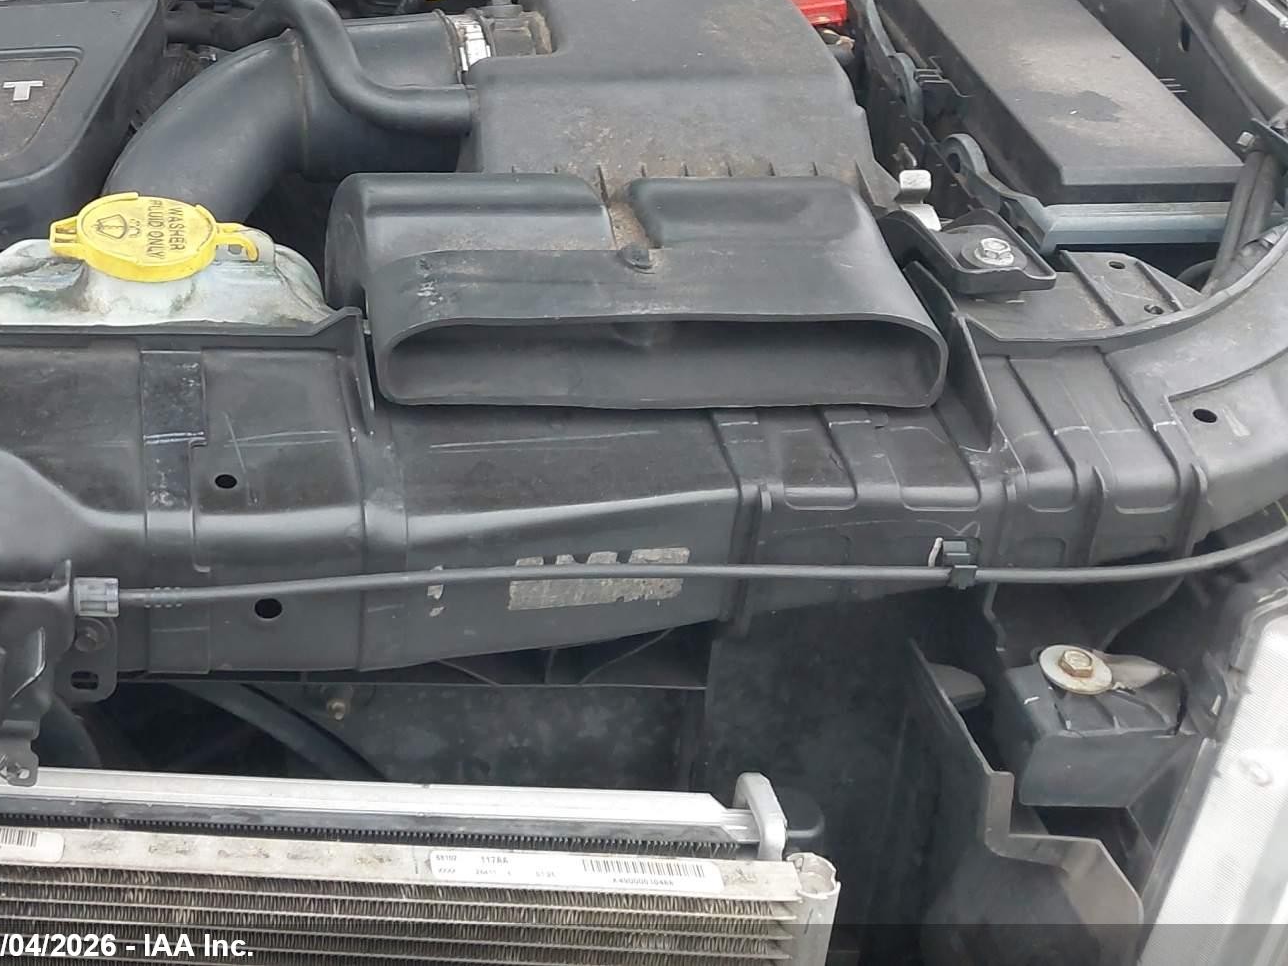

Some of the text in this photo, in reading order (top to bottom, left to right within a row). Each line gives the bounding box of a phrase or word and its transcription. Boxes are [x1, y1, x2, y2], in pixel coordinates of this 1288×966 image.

[146, 199, 165, 259] FLUID ONLY
[168, 207, 187, 251] WASHER
